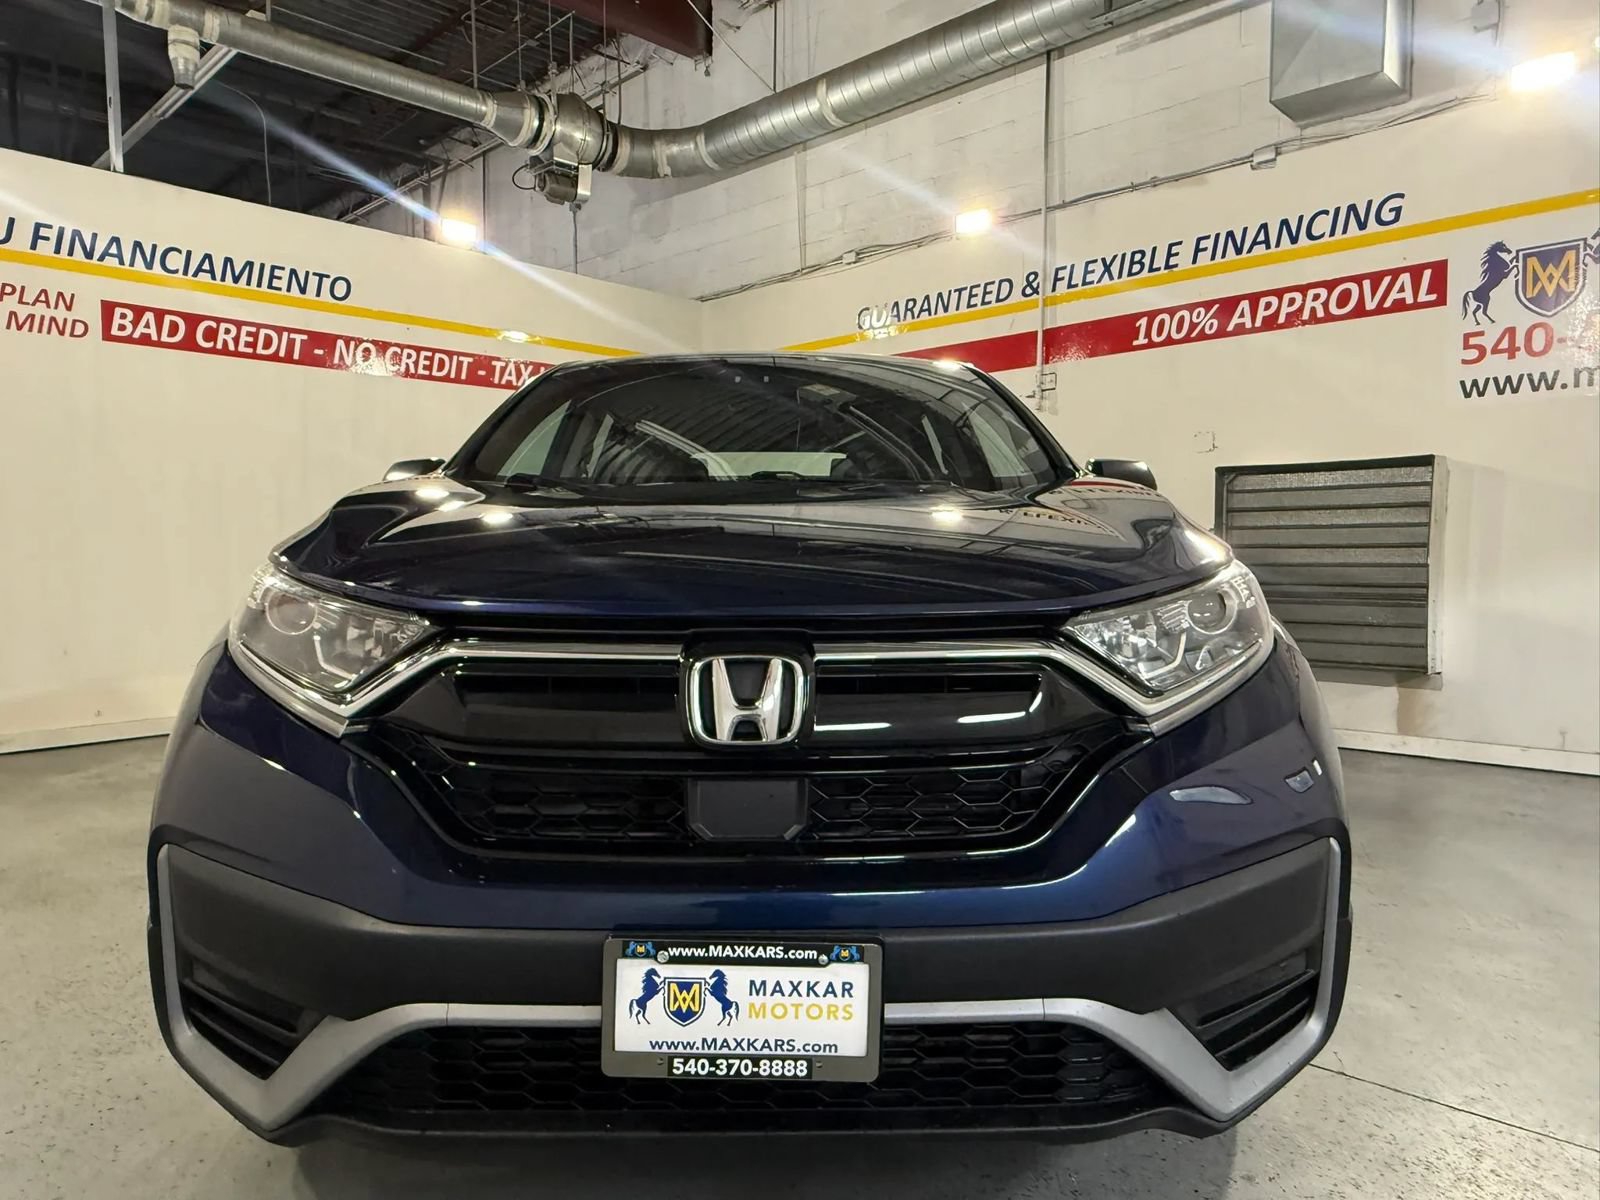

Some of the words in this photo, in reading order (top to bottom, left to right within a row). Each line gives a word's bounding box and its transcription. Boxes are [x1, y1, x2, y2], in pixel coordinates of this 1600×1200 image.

[29, 221, 353, 302] FINANCIAMIENTO
[856, 277, 1014, 330] GUARANTEED
[1021, 270, 1040, 298] &
[1051, 240, 1184, 293] FLEXIBLE
[1191, 192, 1406, 265] FINANCING
[0, 282, 76, 313] PLAN
[1132, 303, 1220, 346] 100%
[1226, 268, 1438, 331] APPROVAL
[5, 310, 90, 339] MIND
[110, 306, 186, 344] BAD
[195, 319, 308, 361] CREDIT
[333, 339, 377, 367] NO
[385, 345, 474, 381] CREDIT
[491, 359, 534, 387] TAX
[667, 944, 818, 961] www.MAXKARS.com
[749, 979, 855, 999] MAXKAR
[748, 1002, 854, 1021] MOTORS
[649, 1037, 839, 1054] www.MAXKARS.com
[672, 1058, 808, 1077] 540-370-8888
